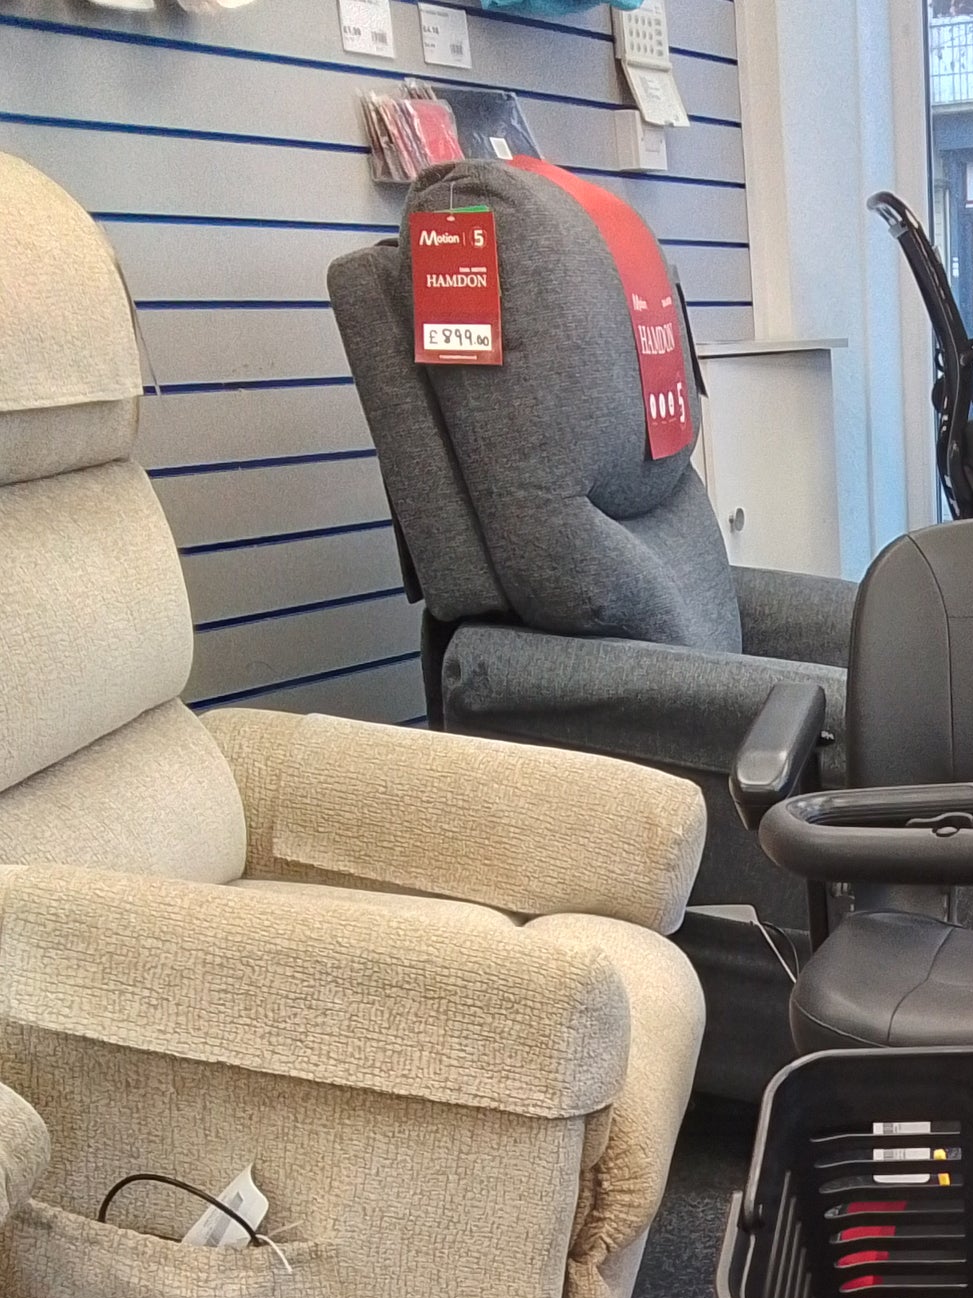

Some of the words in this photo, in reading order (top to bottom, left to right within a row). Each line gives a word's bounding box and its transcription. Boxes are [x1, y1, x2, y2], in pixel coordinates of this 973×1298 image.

[419, 230, 459, 246] Motion
[473, 229, 484, 246] 5
[427, 274, 487, 287] HAMDON
